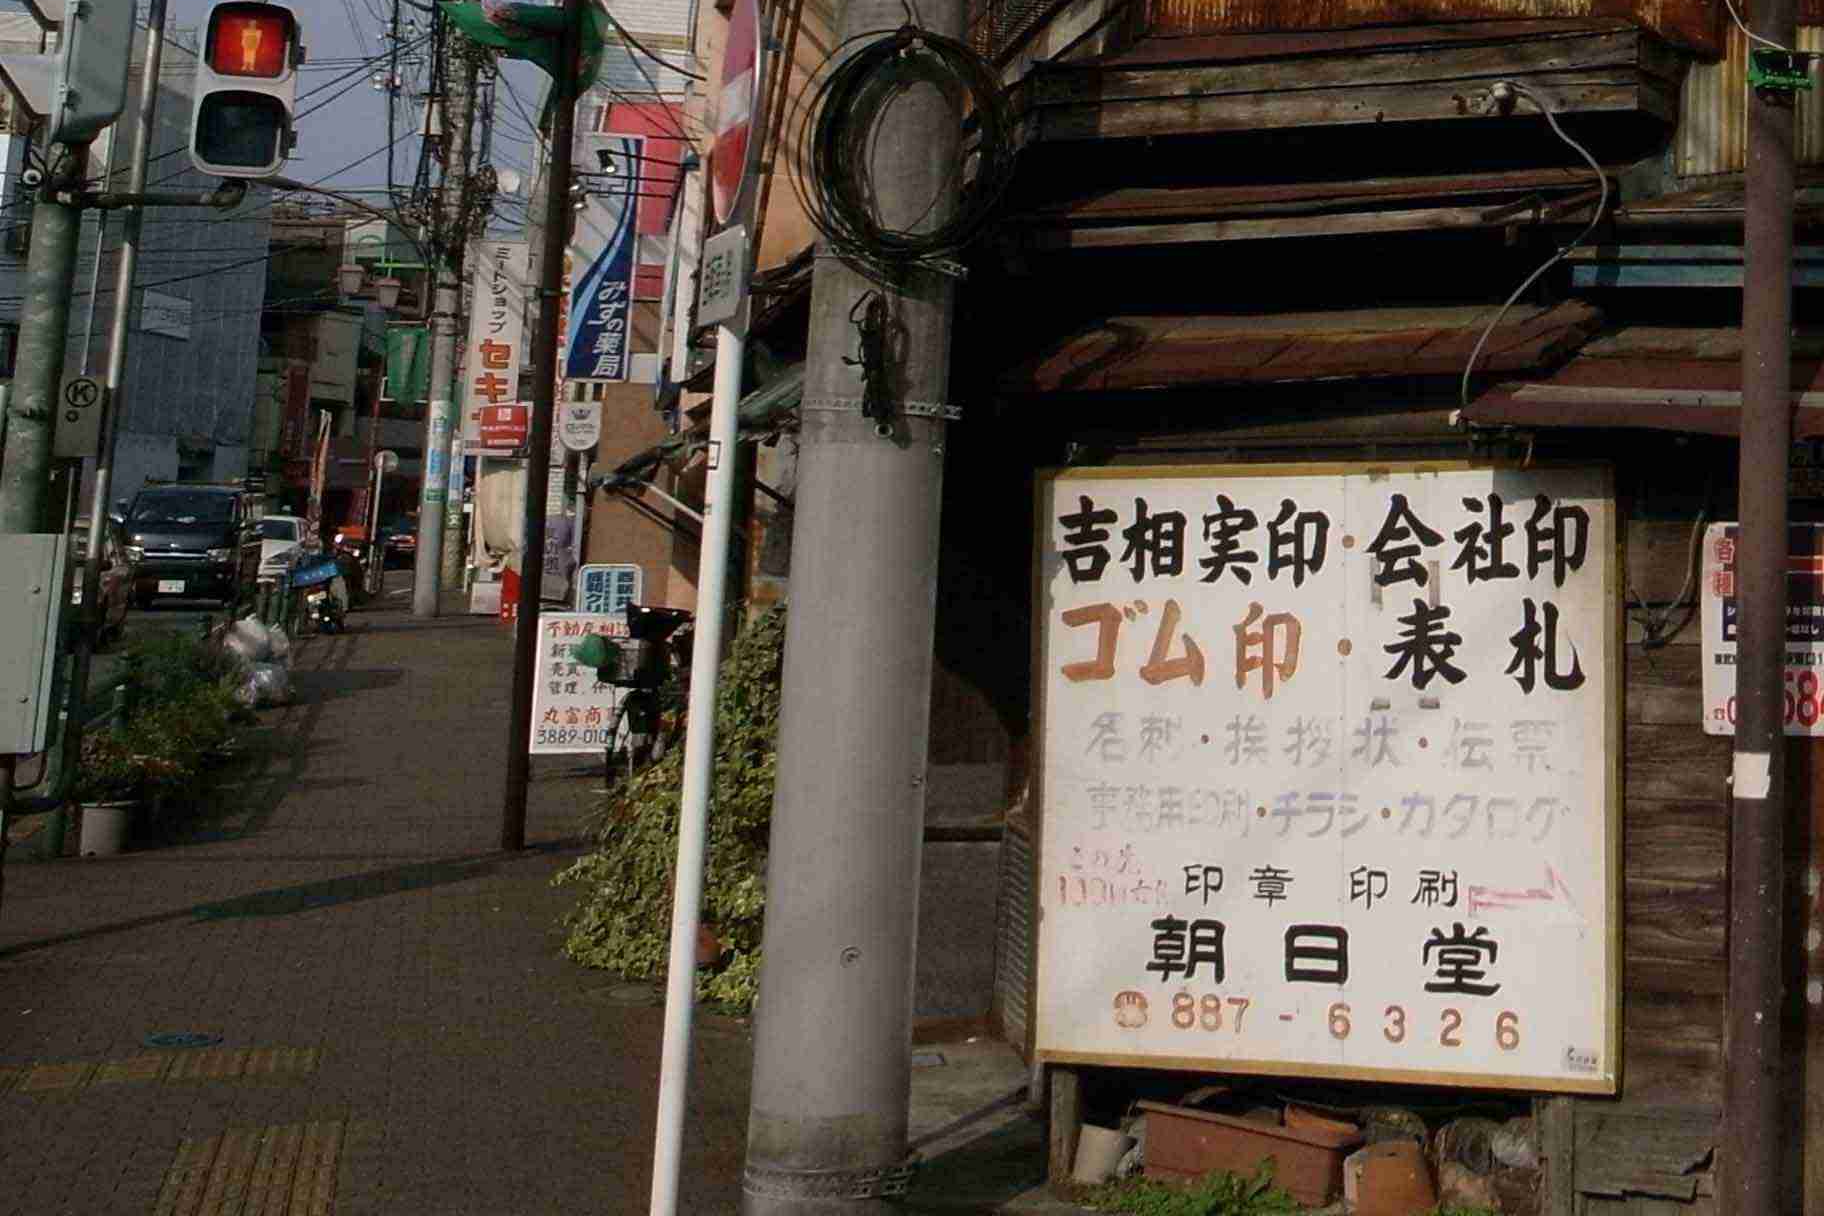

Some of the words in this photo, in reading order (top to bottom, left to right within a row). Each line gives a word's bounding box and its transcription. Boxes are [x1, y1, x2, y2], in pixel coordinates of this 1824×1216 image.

[488, 247, 511, 333] ミートショップ
[472, 338, 512, 421] セキ
[1058, 494, 1591, 589] 吉相実印・会社印
[1060, 598, 1586, 698] ゴム印・表札
[1184, 864, 1294, 910] 印章
[1349, 865, 1459, 911] 印刷
[1146, 915, 1501, 997] 朝日堂
